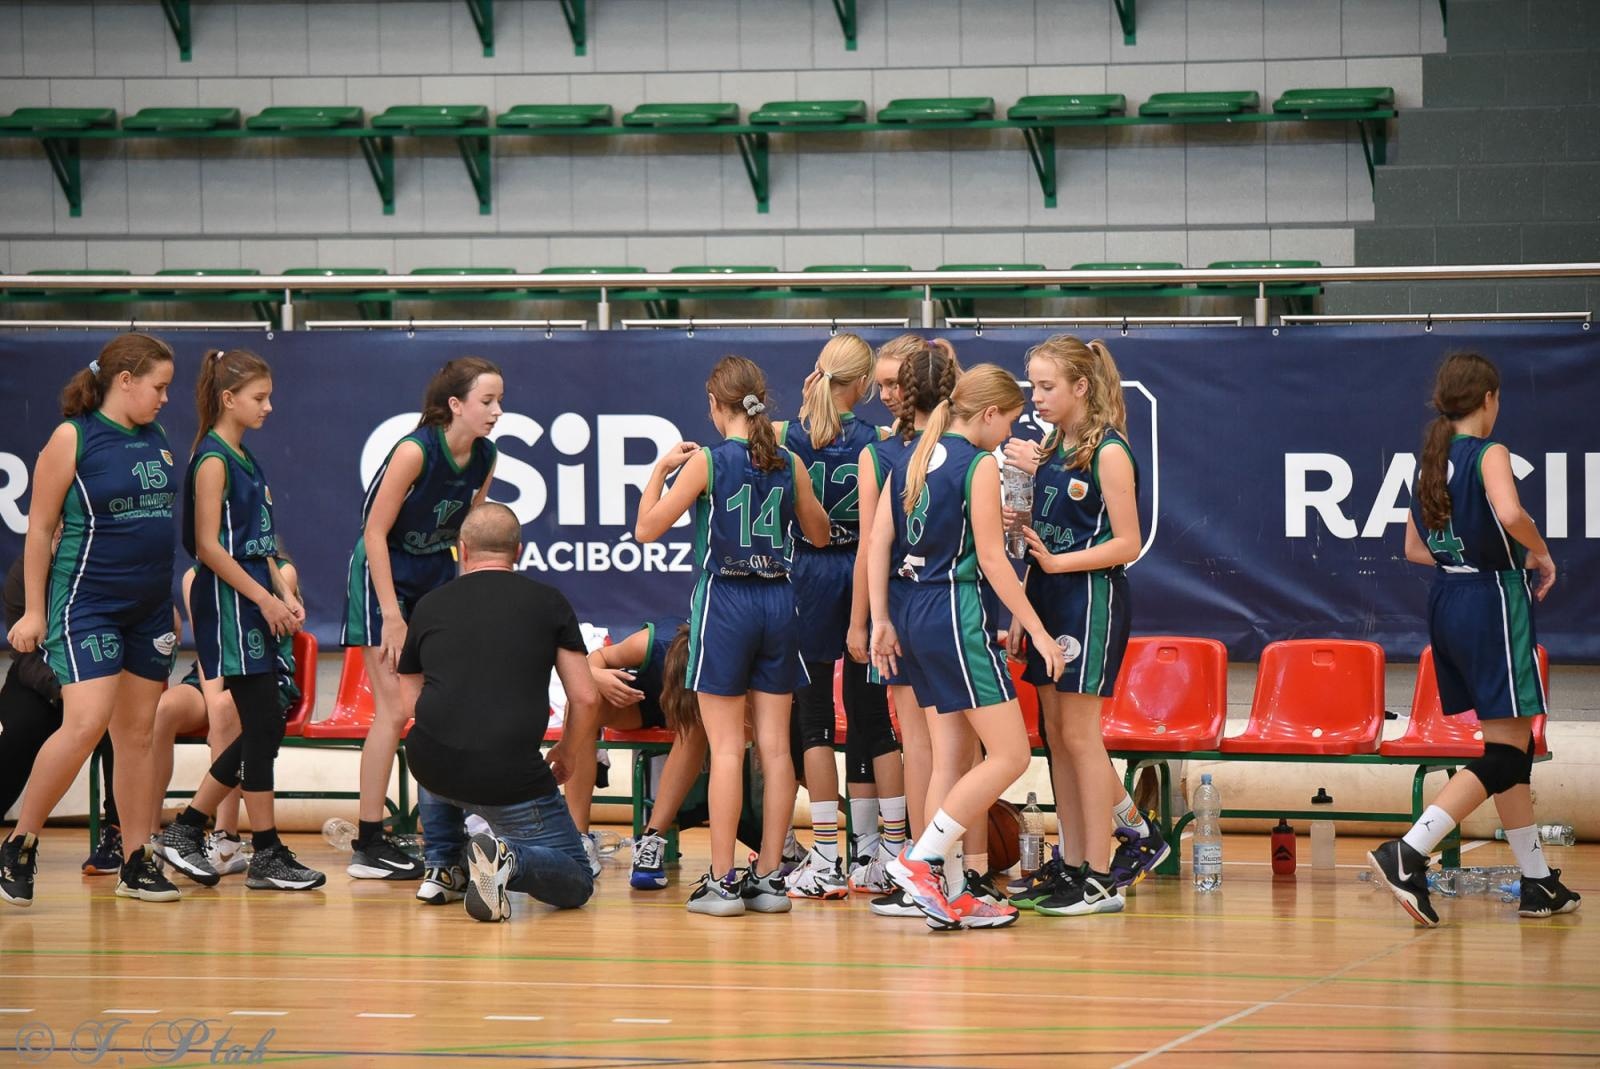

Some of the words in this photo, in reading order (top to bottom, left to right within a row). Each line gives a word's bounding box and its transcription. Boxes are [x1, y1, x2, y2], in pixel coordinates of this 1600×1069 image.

[131, 460, 168, 490] 15
[807, 461, 859, 521] 12
[1041, 485, 1059, 517] 7
[1284, 452, 1600, 539] RAI
[726, 483, 785, 549] 14
[512, 532, 693, 572] ACIBÓRZ
[80, 633, 120, 663] 15
[247, 628, 265, 659] 9
